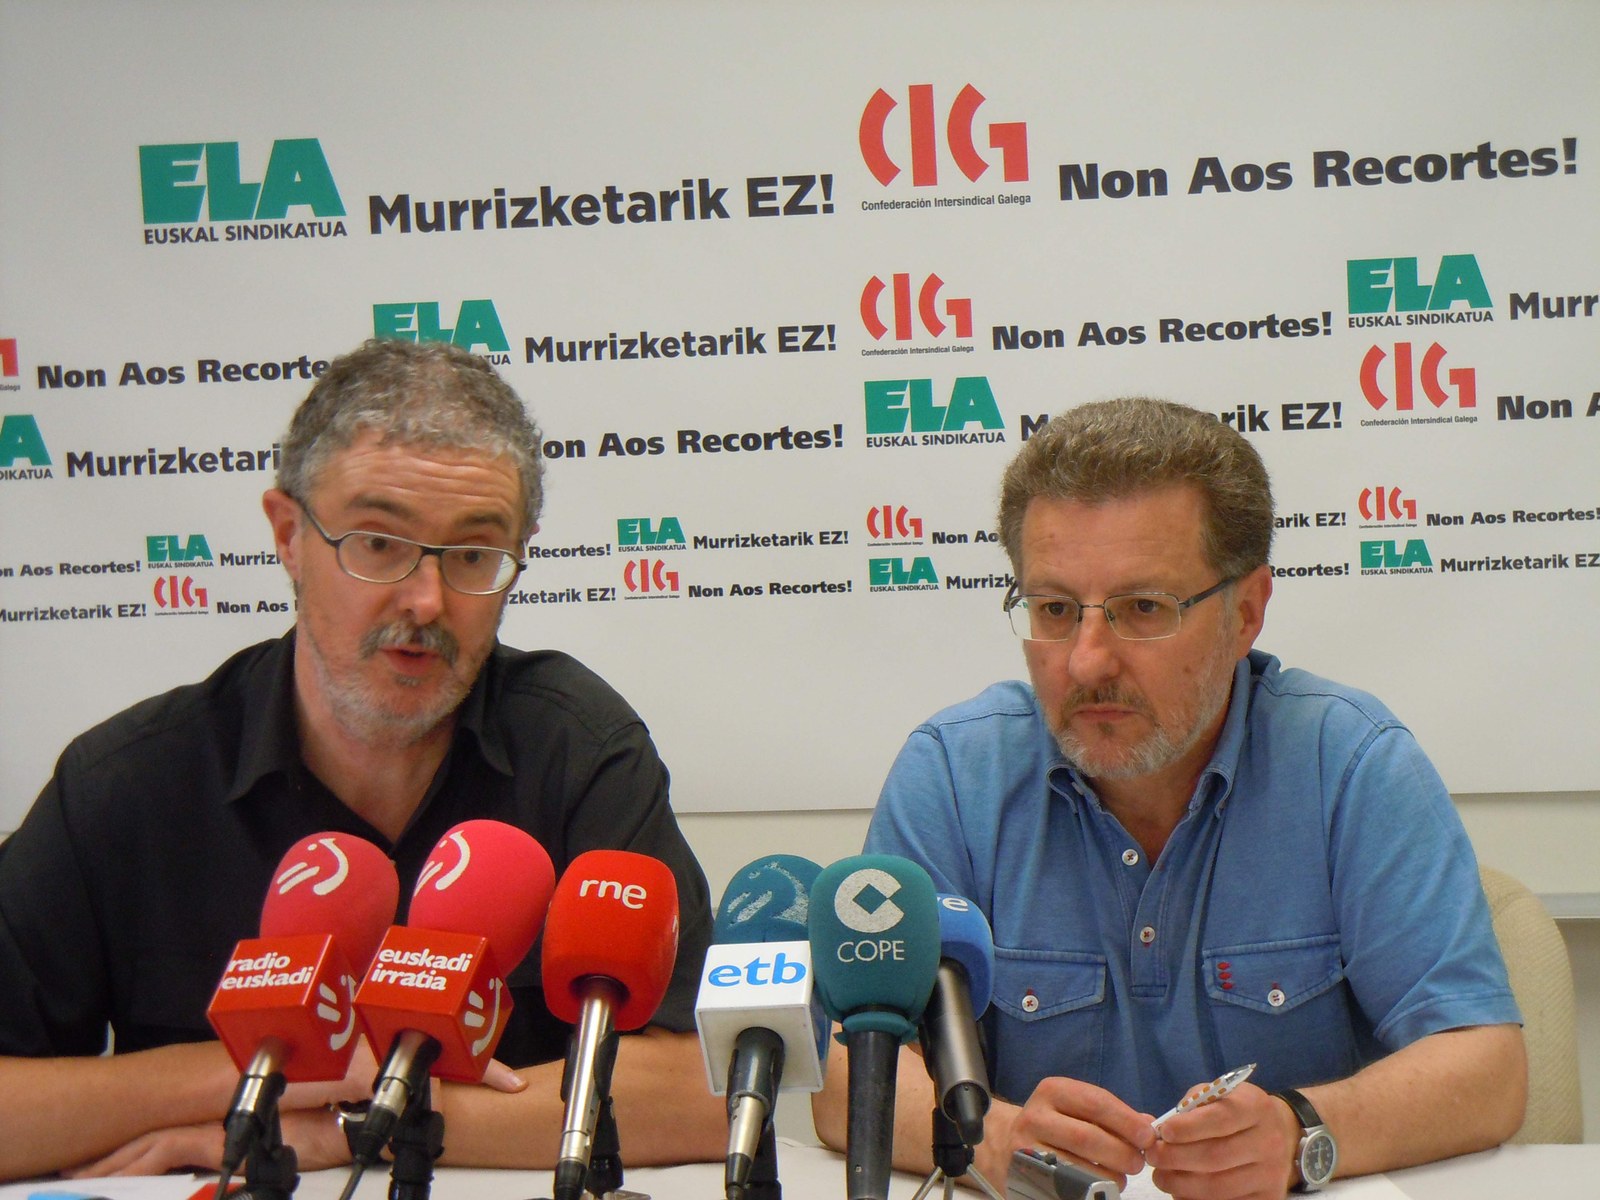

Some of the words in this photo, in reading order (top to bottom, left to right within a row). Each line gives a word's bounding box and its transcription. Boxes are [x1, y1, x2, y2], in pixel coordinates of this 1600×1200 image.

[859, 83, 1029, 187] CIG
[139, 138, 346, 224] ELA
[1059, 163, 1168, 200] Non
[1188, 157, 1293, 194] Aos
[1313, 137, 1577, 187] Recortes!
[369, 178, 730, 234] Murrizketarik
[746, 174, 834, 217] EZ!
[862, 198, 931, 210] Confederación
[935, 195, 994, 207] Intersindical
[998, 194, 1031, 205] Galega
[144, 227, 218, 244] EUSKAL
[225, 221, 347, 242] SINDIKATUA
[1347, 254, 1493, 314] ELA
[860, 273, 973, 341] CIG
[1348, 314, 1403, 328] EUSKAL
[1406, 310, 1494, 326] SINDIKATUA
[525, 327, 767, 363] Murrizketarik
[778, 324, 836, 353] EZ!
[992, 326, 1064, 350] Non
[1077, 322, 1146, 346] Aos
[1160, 311, 1331, 343] Recortes!
[37, 365, 106, 389] Non
[119, 362, 185, 386] Aos
[198, 355, 328, 383] Recorte
[1360, 342, 1476, 411] CIG
[865, 376, 1005, 433] ELA
[1282, 402, 1342, 430] EZ!
[1497, 396, 1572, 420] Non
[1361, 418, 1409, 426] Confederación
[1411, 416, 1452, 424] Intersindical
[541, 437, 585, 460] on
[598, 433, 665, 457] Aos
[677, 424, 842, 453] Recortes!
[866, 436, 917, 447] EUSKAL
[922, 431, 1005, 445] SINDIKATUA
[66, 444, 280, 478] Murrizketari
[1358, 486, 1417, 521] CIG
[617, 517, 686, 545] ELA
[867, 505, 922, 539] CIG
[1316, 512, 1346, 527] EZ!
[1427, 514, 1464, 526] Non
[1471, 512, 1506, 524] Aos
[146, 534, 213, 561] ELA
[529, 543, 611, 558] Recortes!
[693, 532, 814, 549] Murrizketarik
[819, 531, 848, 545] EZ!
[932, 532, 968, 544] Non
[174, 560, 215, 568] SINDIKATUA
[1360, 539, 1433, 565] ELA
[1441, 554, 1569, 572] Murrizketarik
[20, 565, 53, 576] Aos
[59, 560, 140, 575] Recortes!
[624, 559, 679, 592] CIG
[869, 557, 939, 585] ELA
[1389, 566, 1434, 574] SINDIKATUA
[154, 576, 208, 608] CIG
[508, 589, 582, 605] zketarik
[587, 588, 616, 601] EZ!
[688, 585, 723, 597] Non
[730, 584, 763, 596] Aos
[770, 580, 852, 595] Recortes!
[118, 604, 146, 617] EZ!
[217, 602, 250, 613] Non
[256, 601, 288, 612] Aos
[579, 879, 647, 910] rne
[229, 952, 290, 973] radio
[378, 947, 473, 972] euskadi
[837, 940, 905, 963] COPE
[222, 967, 313, 989] euskadi
[372, 964, 447, 991] irratia
[707, 952, 806, 987] etb
